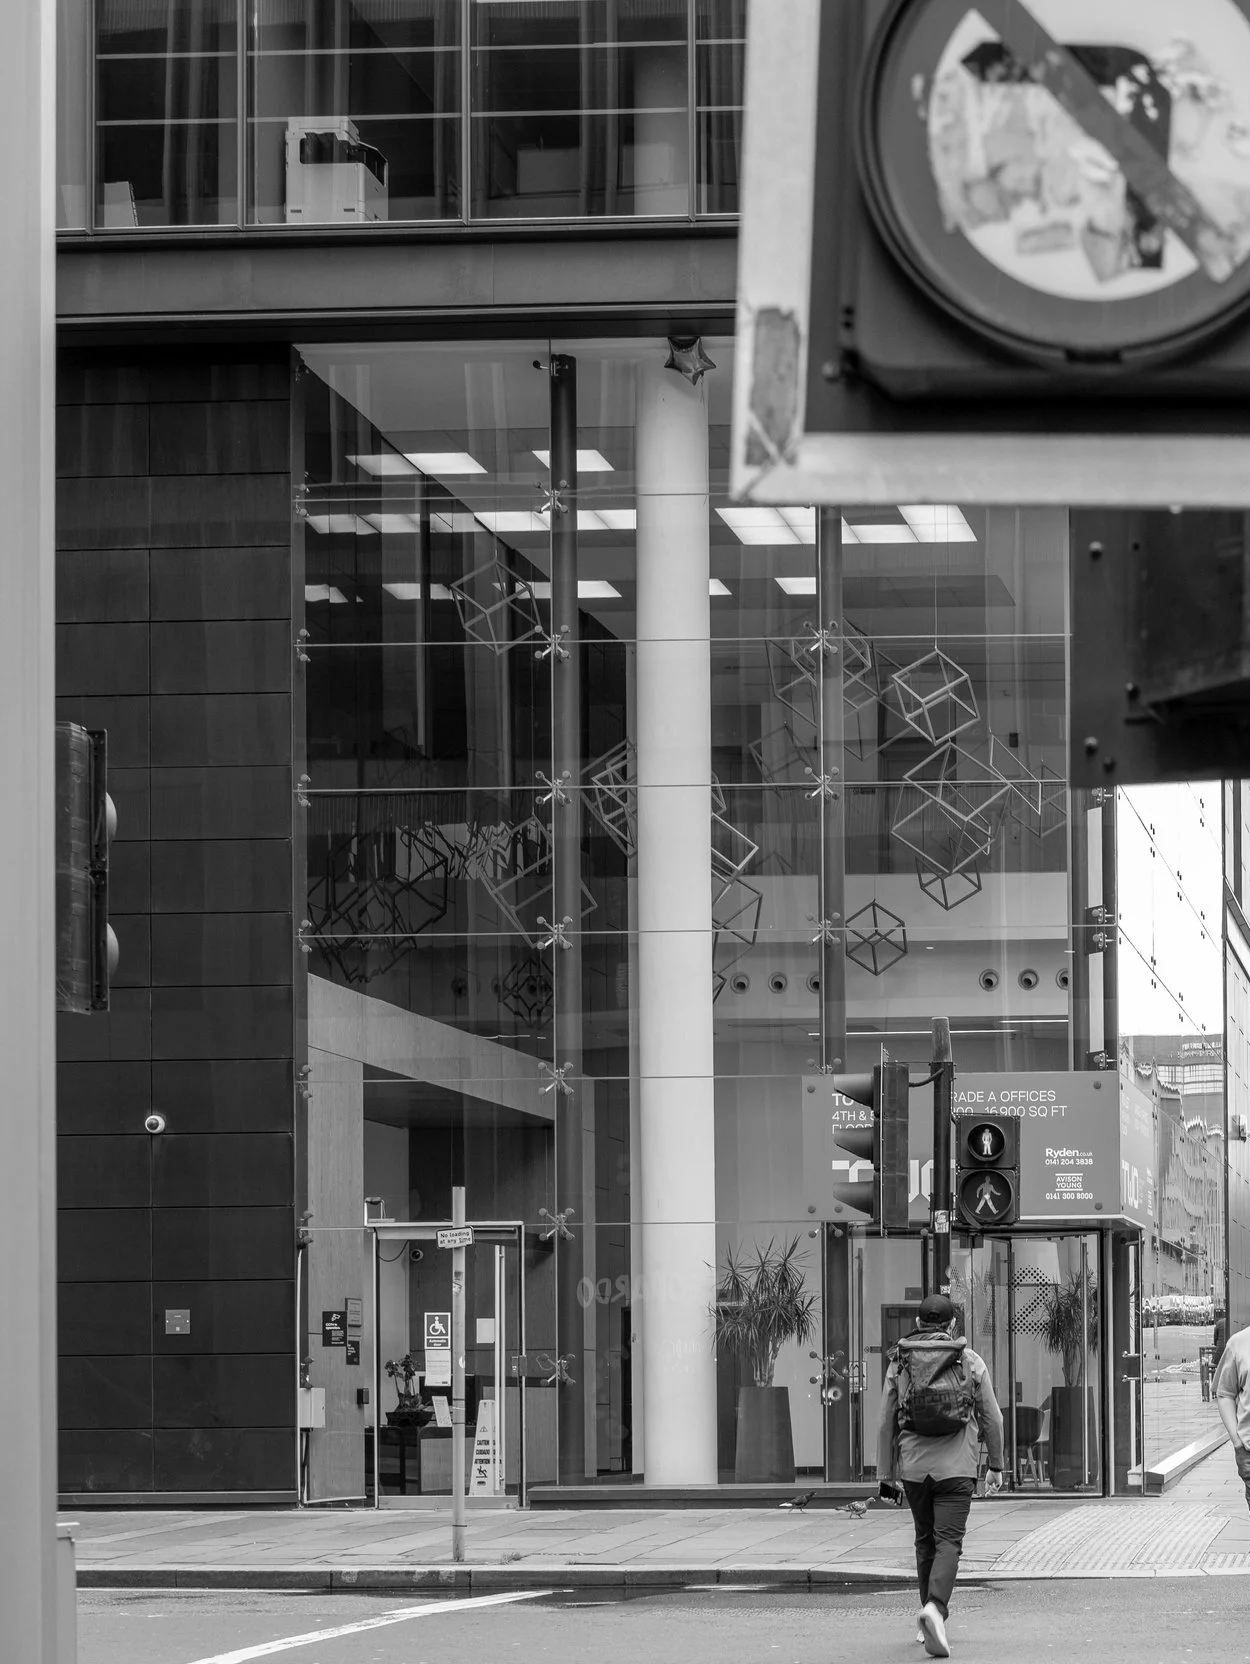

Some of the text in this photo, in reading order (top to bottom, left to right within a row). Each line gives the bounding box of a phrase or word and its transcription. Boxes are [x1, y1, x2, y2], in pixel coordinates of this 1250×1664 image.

[953, 1090, 1056, 1103] RADE A OFFICES
[832, 1110, 856, 1121] 4TH
[858, 1110, 868, 1121] &
[1028, 1105, 1048, 1117] SQ
[1051, 1105, 1067, 1116] FT
[1045, 1192, 1093, 1200] 0141 300 8000
